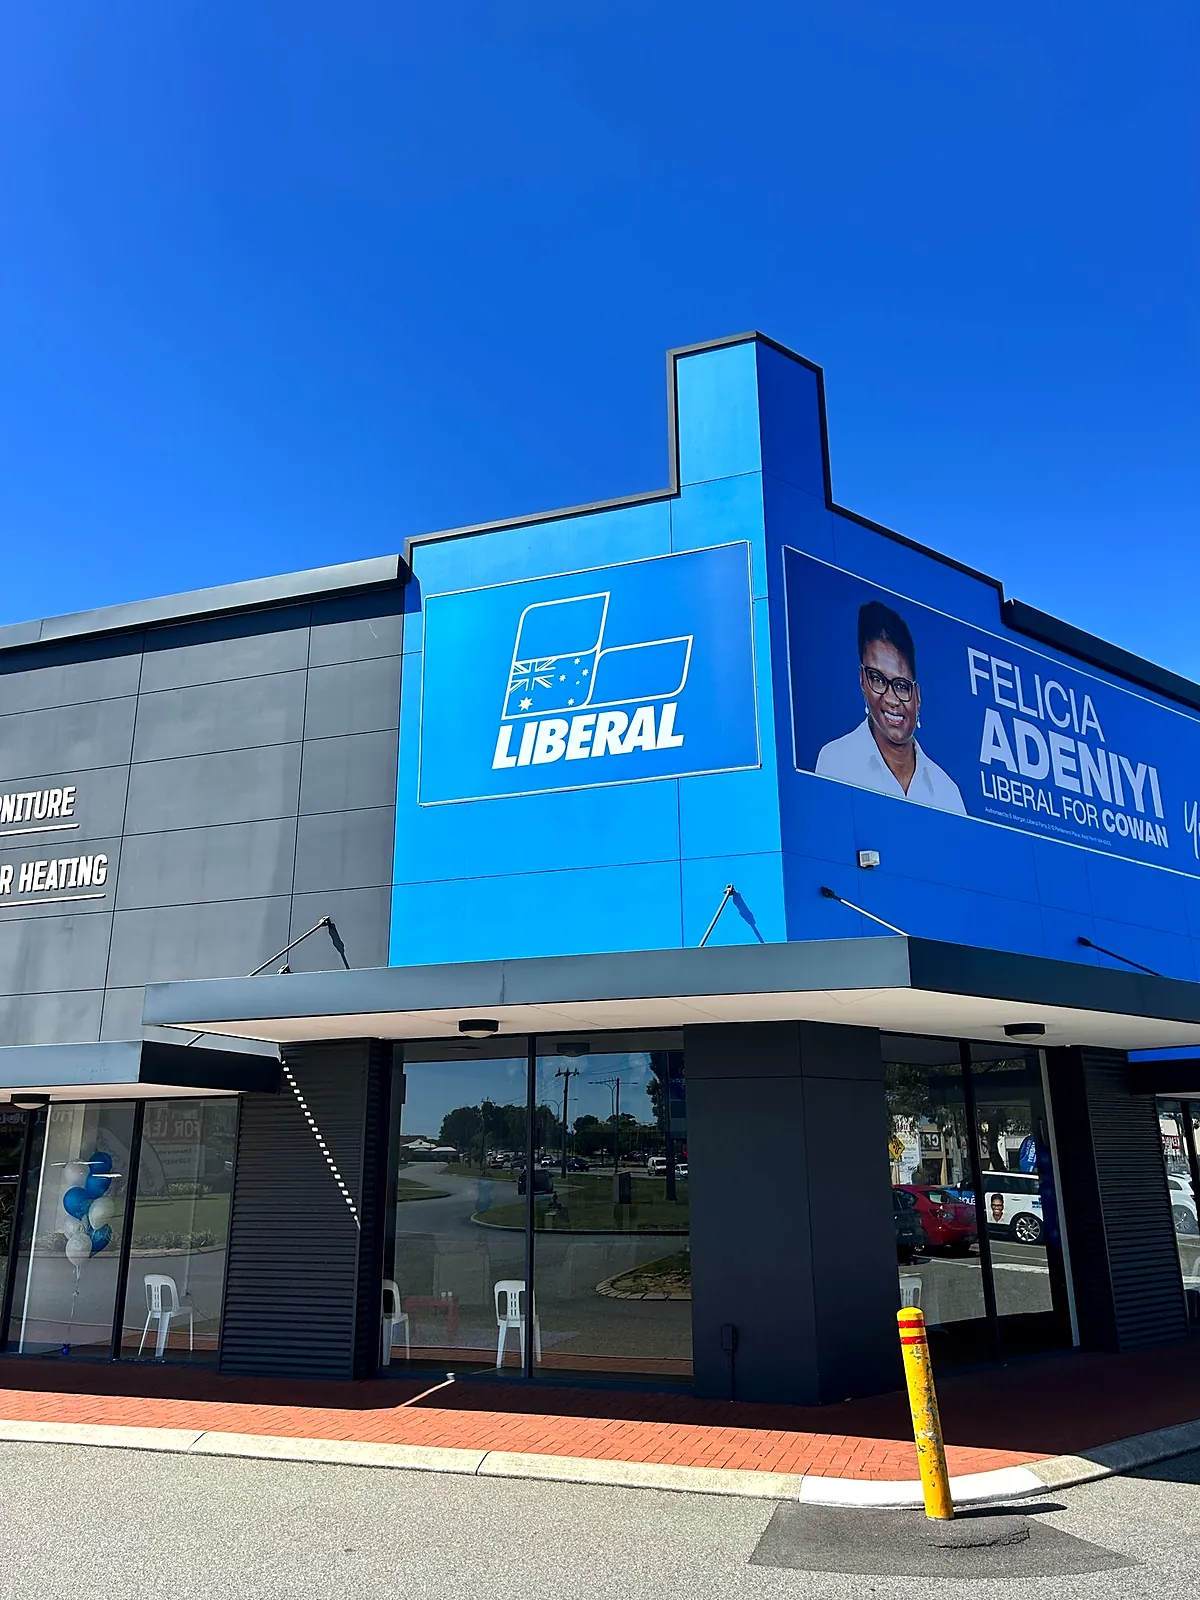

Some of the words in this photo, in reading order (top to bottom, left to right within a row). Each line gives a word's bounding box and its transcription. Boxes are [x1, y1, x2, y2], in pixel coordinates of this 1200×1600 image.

[967, 646, 1105, 742] FELICIA
[491, 702, 684, 769] LIBERAL
[979, 707, 1164, 819] ADENIYI
[0, 787, 76, 824] NITURE
[980, 770, 1060, 818] LIBERAL
[1062, 796, 1099, 829] FOR
[1102, 808, 1168, 848] COWAN
[18, 854, 108, 893] HEATING
